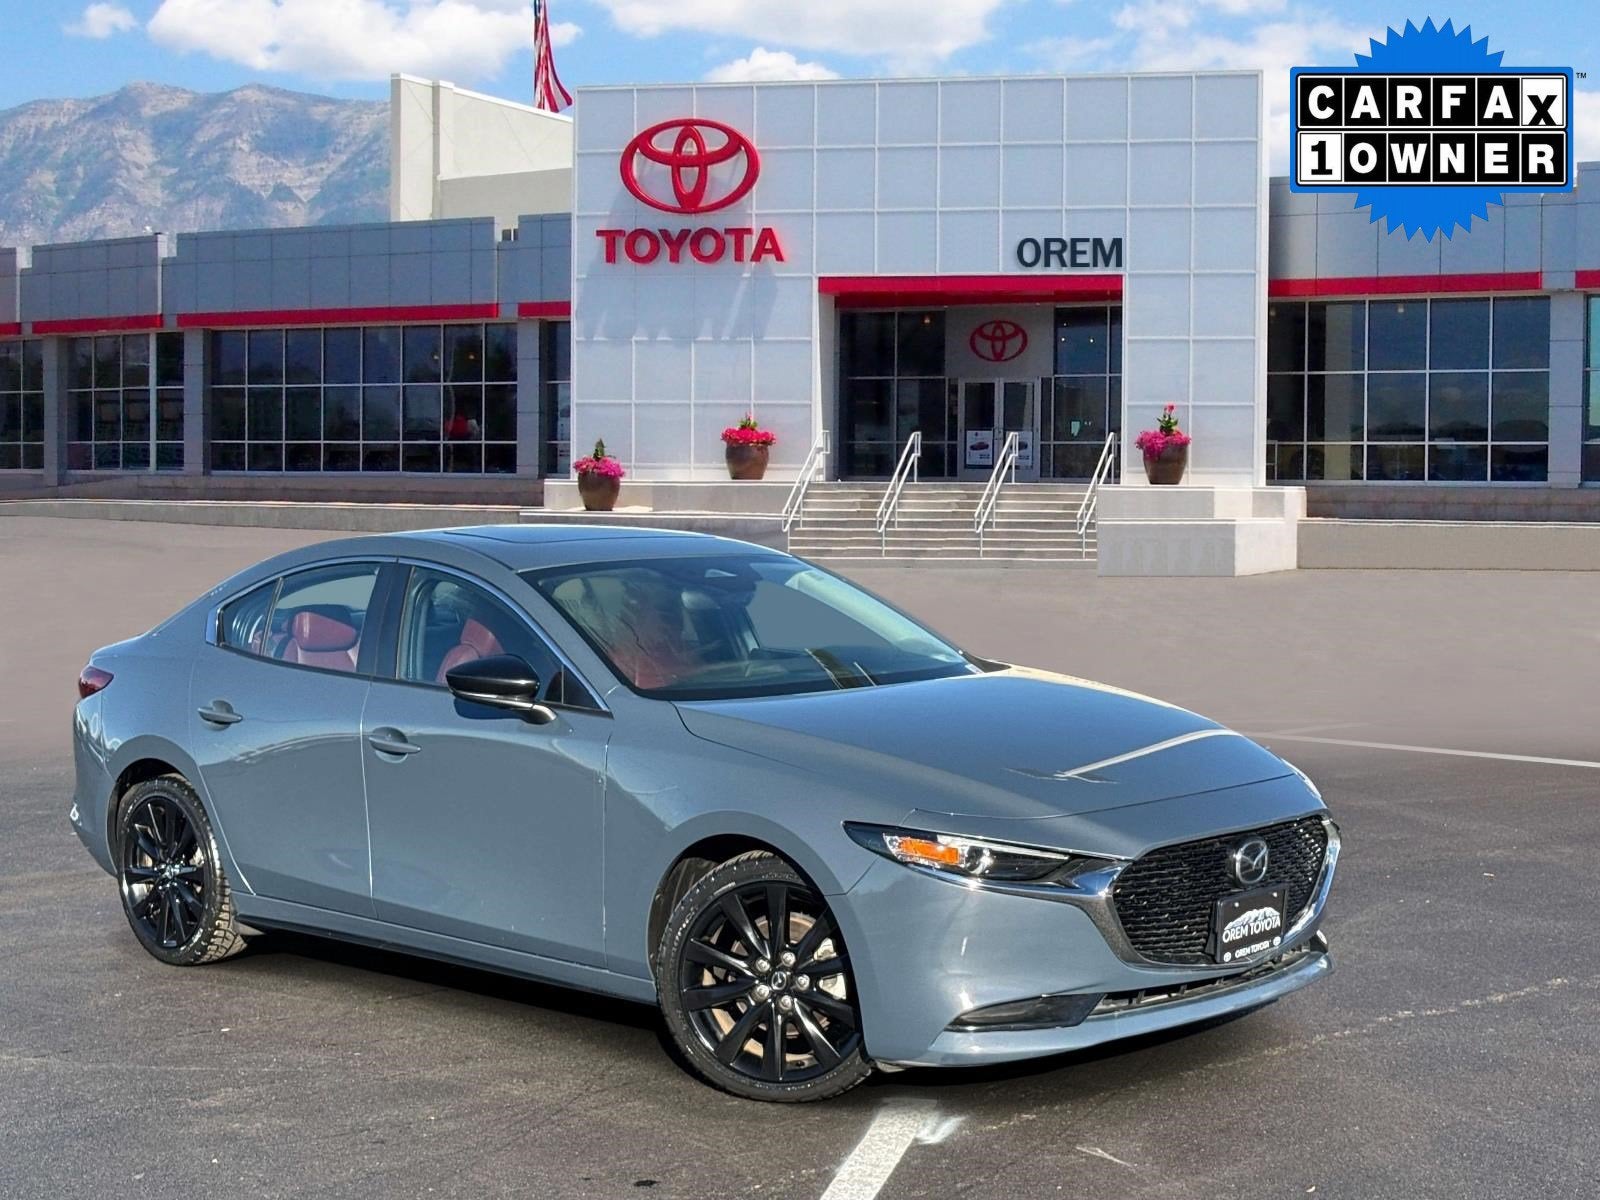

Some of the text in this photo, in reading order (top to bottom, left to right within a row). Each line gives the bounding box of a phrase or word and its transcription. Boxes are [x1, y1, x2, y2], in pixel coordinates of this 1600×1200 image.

[596, 227, 784, 264] TOYOTA
[1017, 237, 1123, 268] OREM
[1222, 915, 1281, 943] OREM TOYOTA
